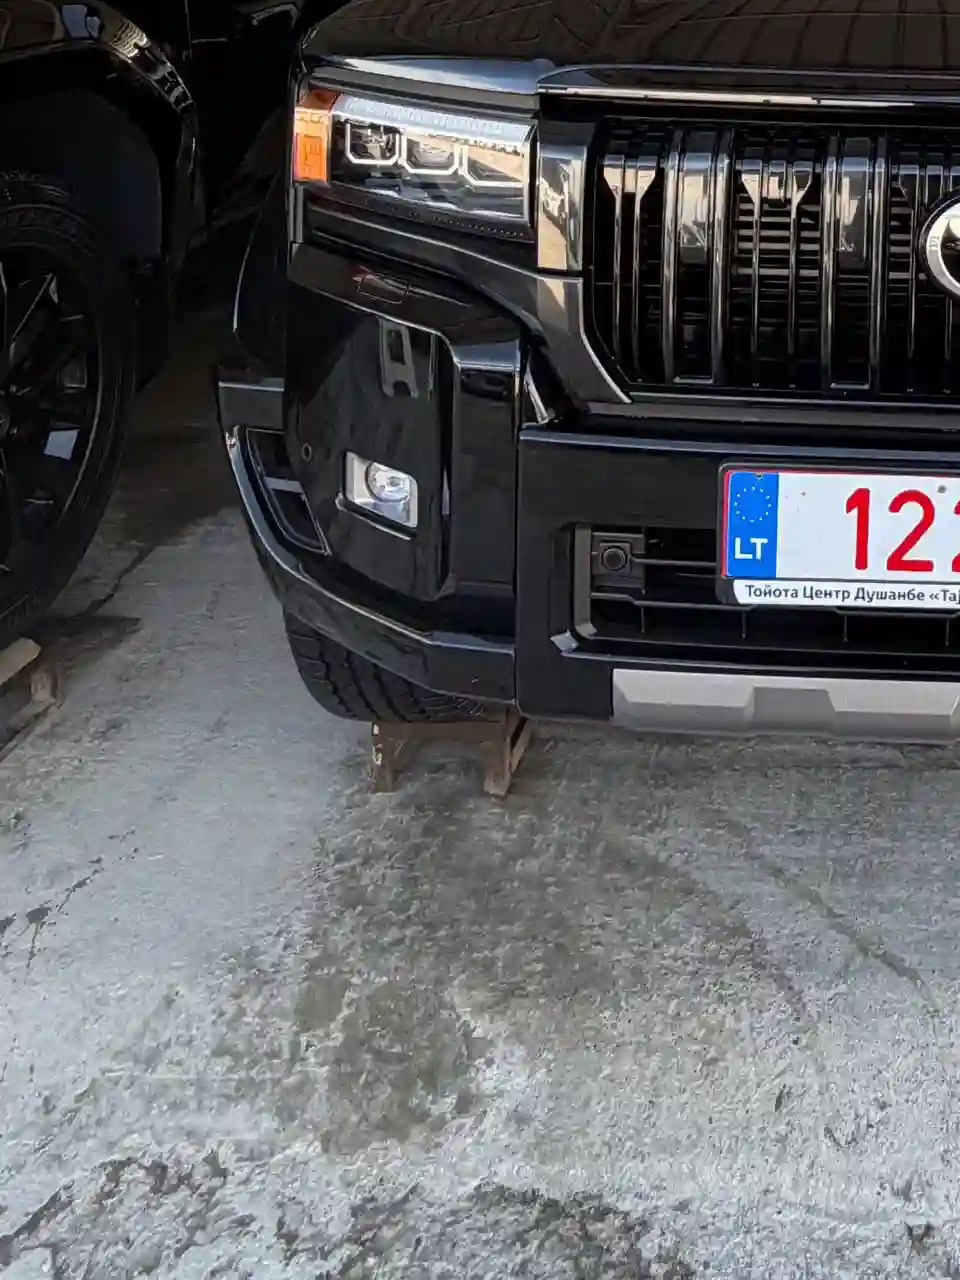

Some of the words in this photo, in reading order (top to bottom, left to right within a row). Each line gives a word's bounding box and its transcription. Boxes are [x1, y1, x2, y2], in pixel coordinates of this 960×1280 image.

[734, 536, 768, 561] LT
[745, 584, 799, 598] Тойота
[803, 586, 851, 602] Центр
[854, 587, 925, 603] Душанбе
